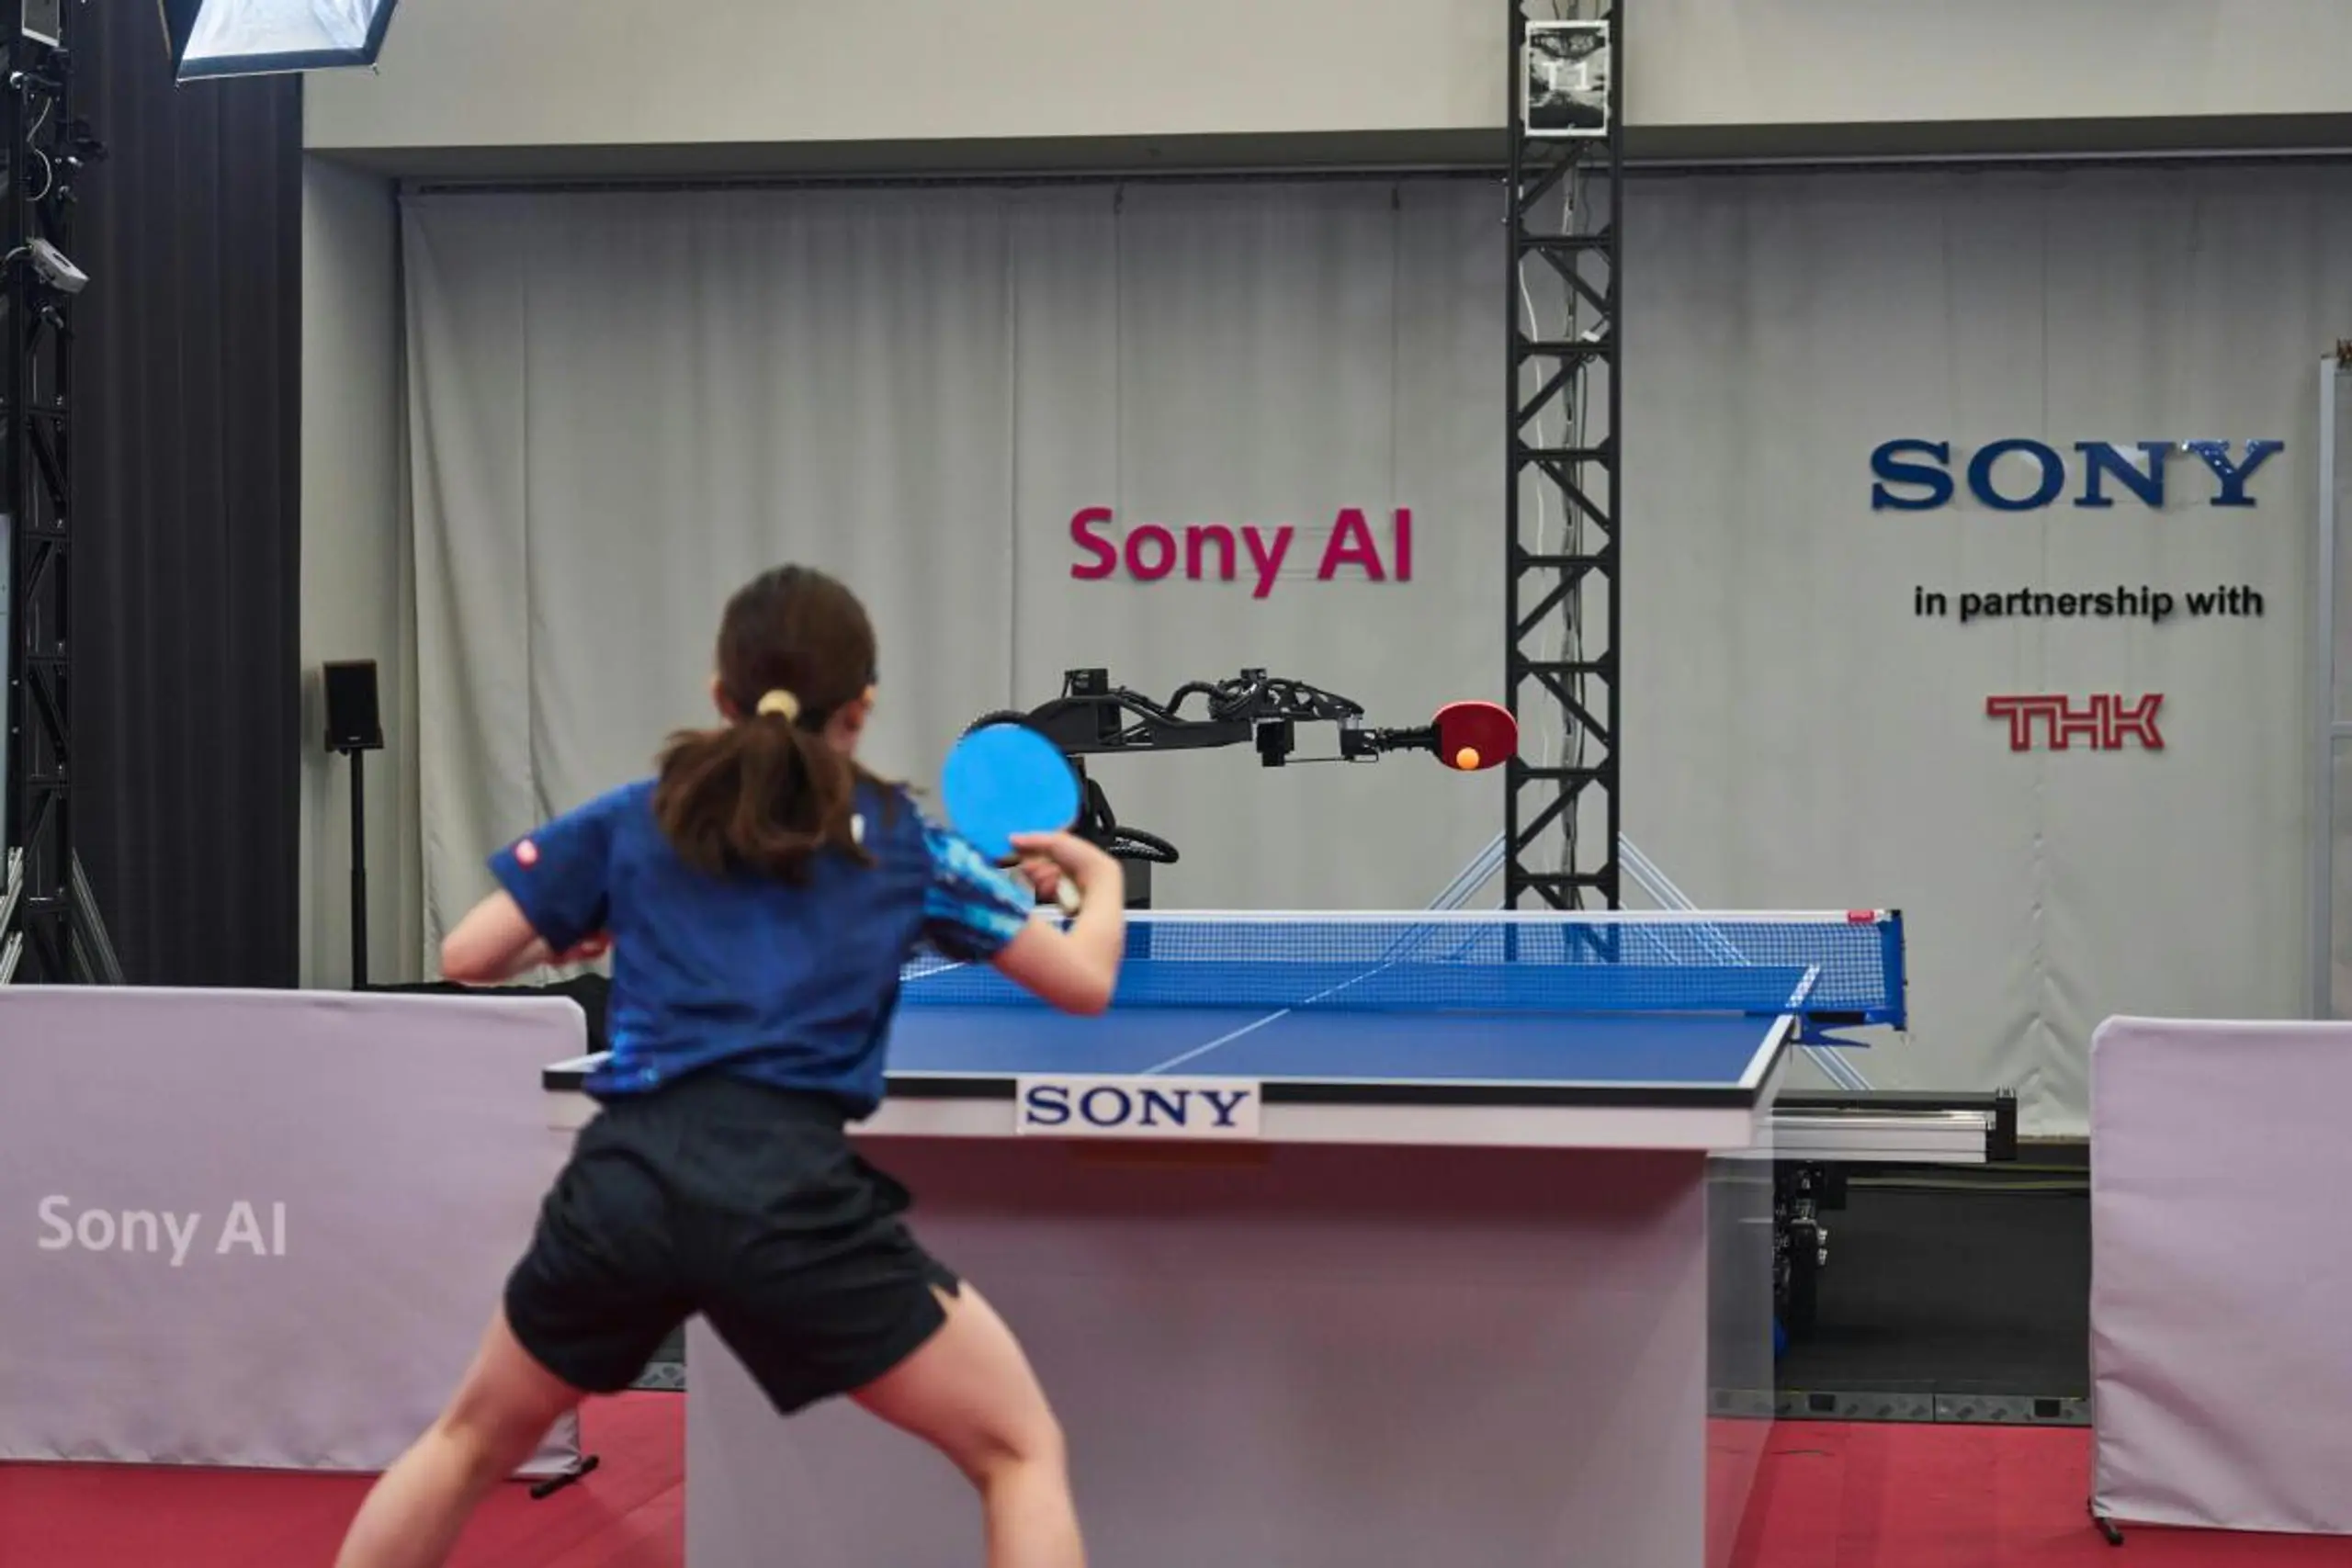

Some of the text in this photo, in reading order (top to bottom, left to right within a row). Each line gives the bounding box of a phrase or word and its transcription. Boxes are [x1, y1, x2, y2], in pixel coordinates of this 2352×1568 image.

[1870, 439, 2282, 512] SONY
[1069, 506, 1413, 599] Sony AI
[1915, 584, 2265, 626] in partnership with
[1986, 693, 2165, 751] THK
[1025, 1085, 1250, 1128] SONY
[37, 1194, 287, 1267] Sony AI
